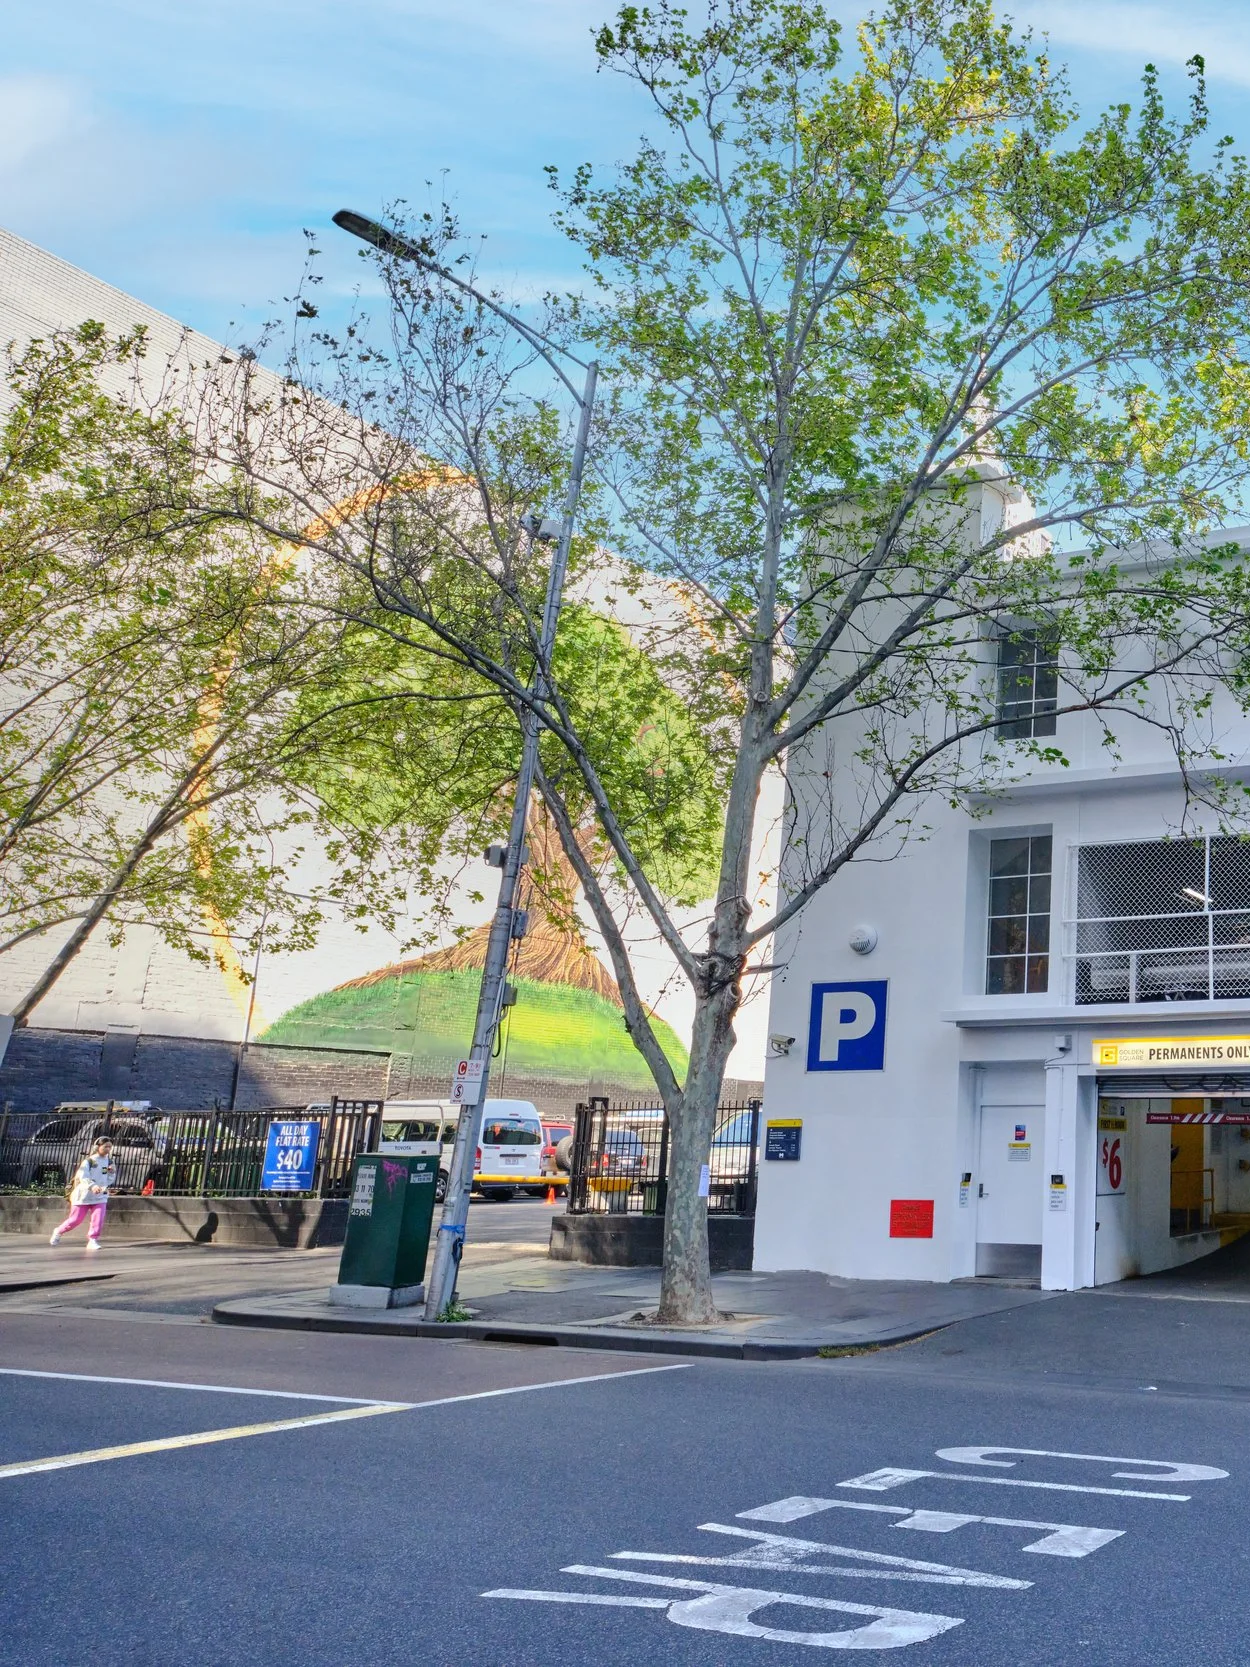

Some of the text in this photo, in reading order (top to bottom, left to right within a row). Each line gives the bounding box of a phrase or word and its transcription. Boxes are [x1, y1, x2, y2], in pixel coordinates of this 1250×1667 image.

[818, 991, 877, 1062] P
[1119, 1048, 1145, 1056] GOLDEN
[1119, 1054, 1144, 1062] SQUARE
[1148, 1046, 1224, 1061] PERMANENTS
[280, 1125, 309, 1136] ALL DAY
[275, 1136, 310, 1147] FLAT RATE
[276, 1149, 303, 1170] $40
[1102, 1137, 1122, 1190] $6
